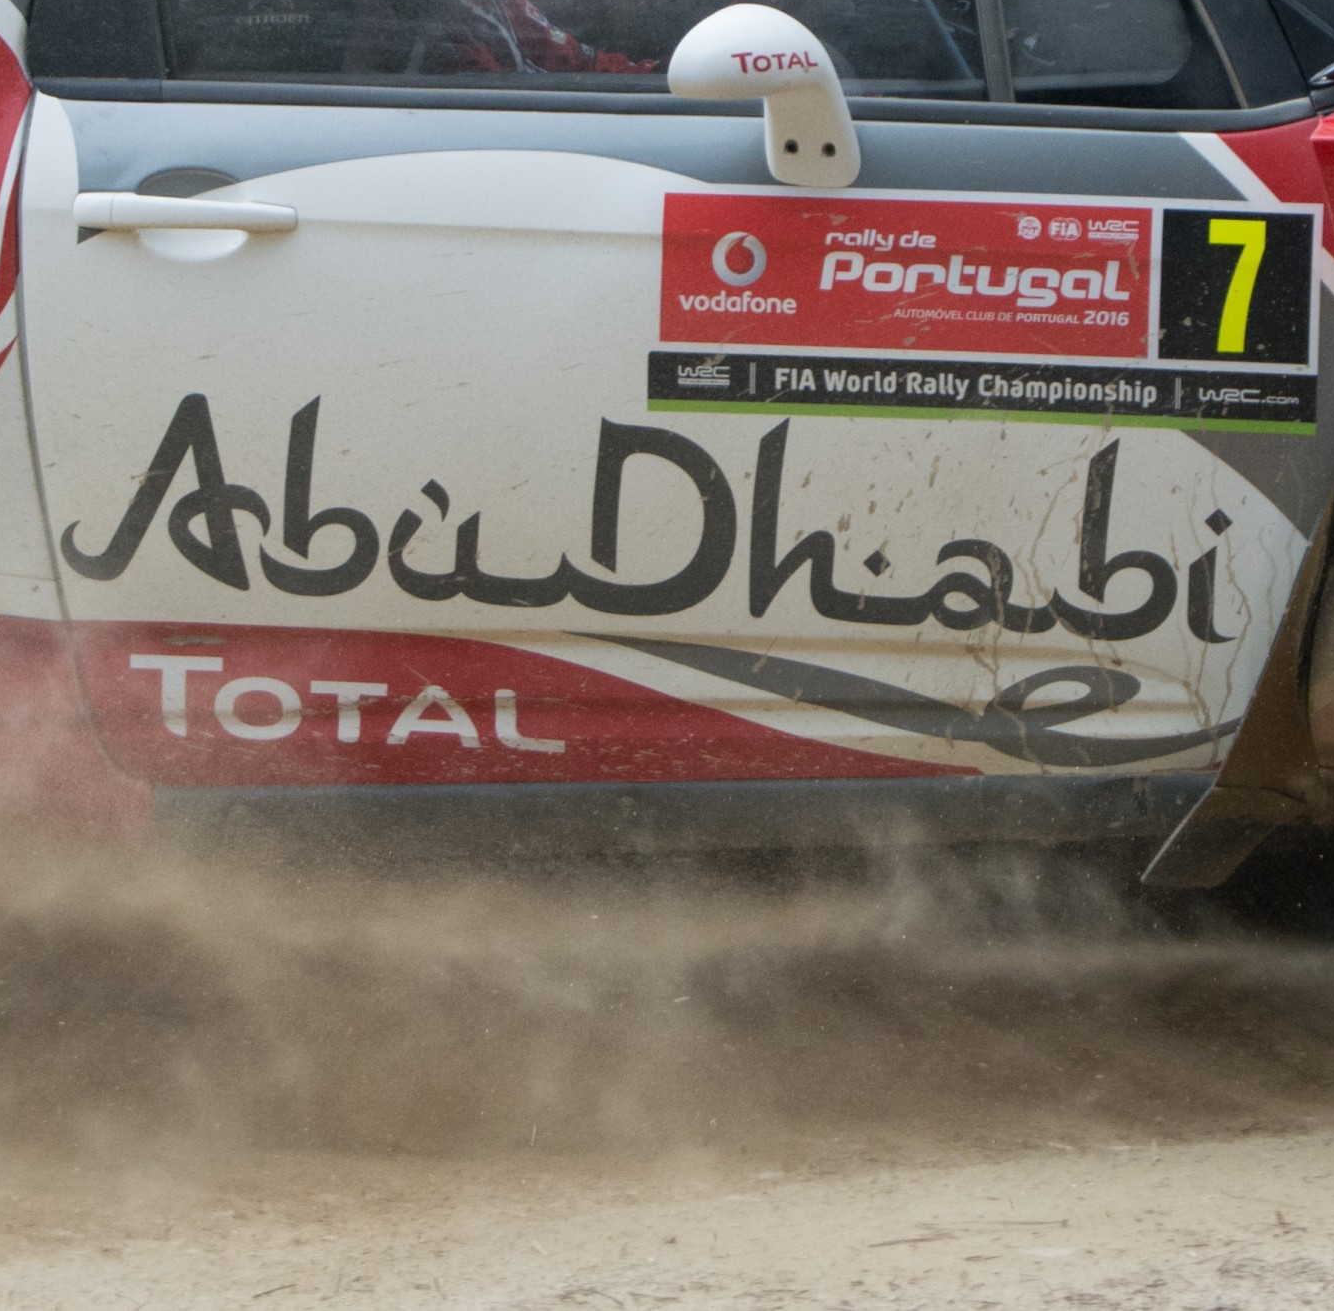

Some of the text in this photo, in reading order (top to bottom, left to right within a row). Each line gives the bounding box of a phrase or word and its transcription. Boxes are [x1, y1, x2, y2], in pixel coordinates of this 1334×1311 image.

[731, 51, 819, 74] TOTAL
[1088, 219, 1140, 232] WRC
[826, 228, 937, 251] rally de
[819, 250, 1130, 308] Portugal
[1208, 218, 1267, 353] 7
[679, 291, 797, 315] vodafone
[966, 311, 995, 322] CLUB
[998, 312, 1013, 322] DE
[1016, 313, 1080, 324] PORTUGAL
[1083, 310, 1130, 327] 2016
[677, 364, 731, 378] WRC
[775, 367, 1158, 408] FIA World Rally Championship
[129, 652, 566, 753] TOTAL
